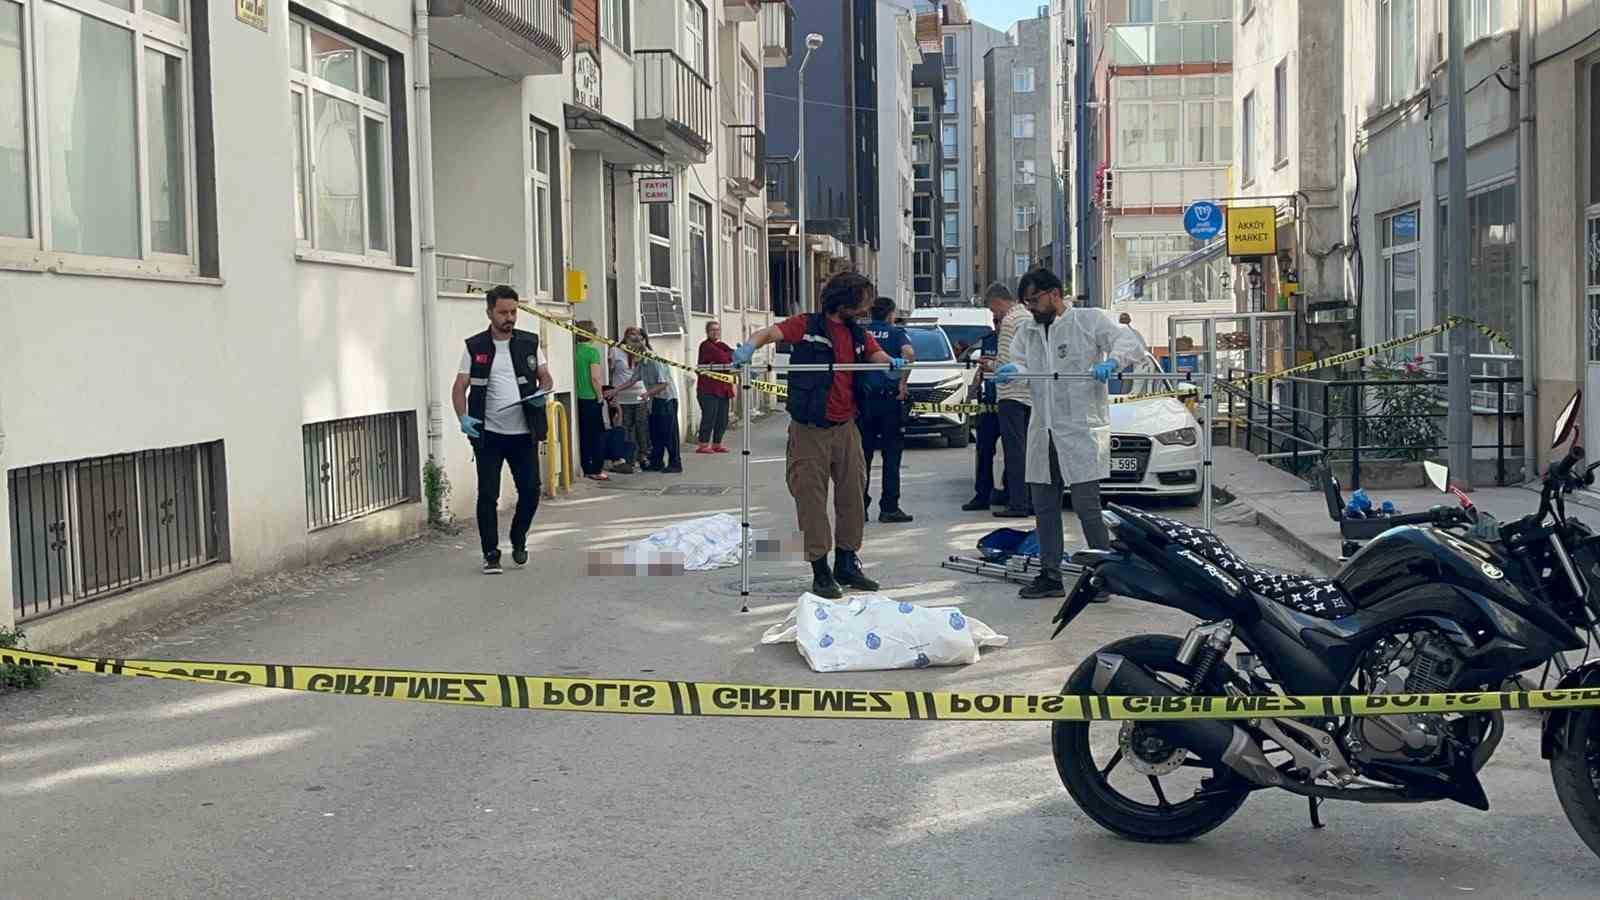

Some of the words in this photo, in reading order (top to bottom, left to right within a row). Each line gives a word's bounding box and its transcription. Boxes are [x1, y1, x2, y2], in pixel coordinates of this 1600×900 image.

[1238, 220, 1265, 230] AKKÖY
[1234, 232, 1269, 242] MARKET
[1119, 459, 1136, 470] 595
